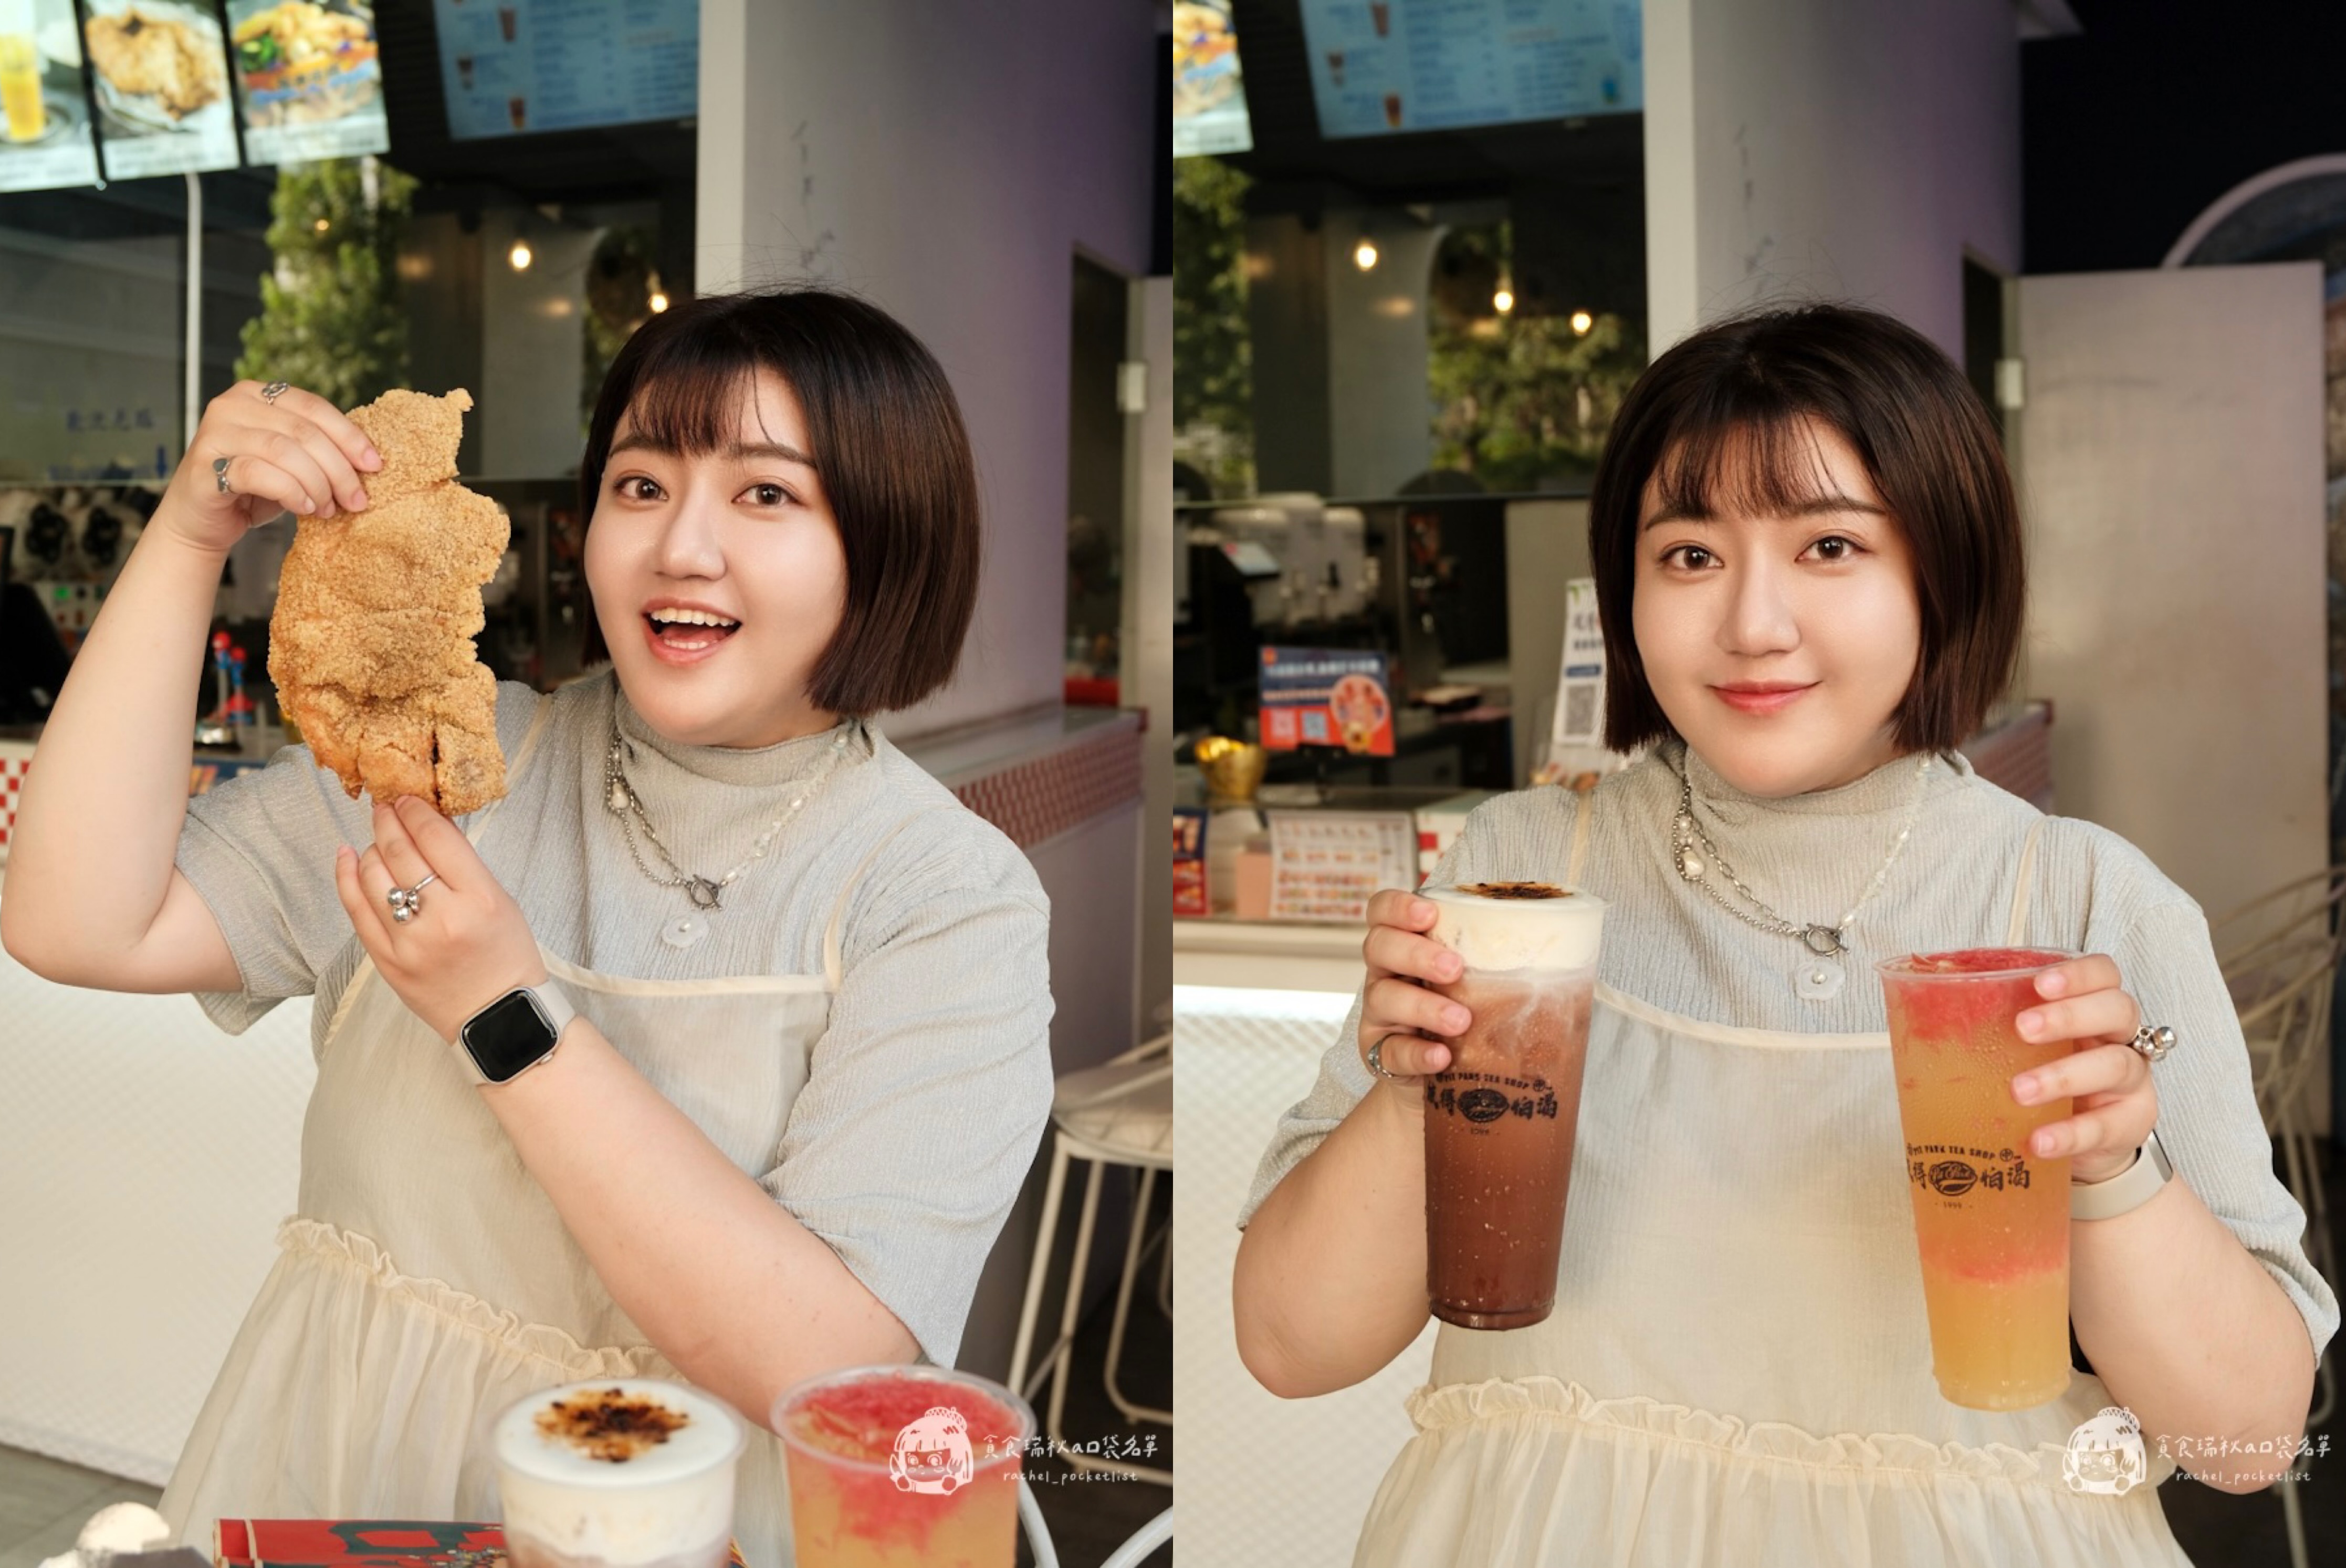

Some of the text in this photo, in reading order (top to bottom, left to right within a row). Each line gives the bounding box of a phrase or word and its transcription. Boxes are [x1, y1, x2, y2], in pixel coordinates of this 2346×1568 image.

[1505, 1078, 1529, 1089] SHOP
[1949, 1145, 1965, 1154] TEA
[1970, 1148, 1995, 1160] SHOP
